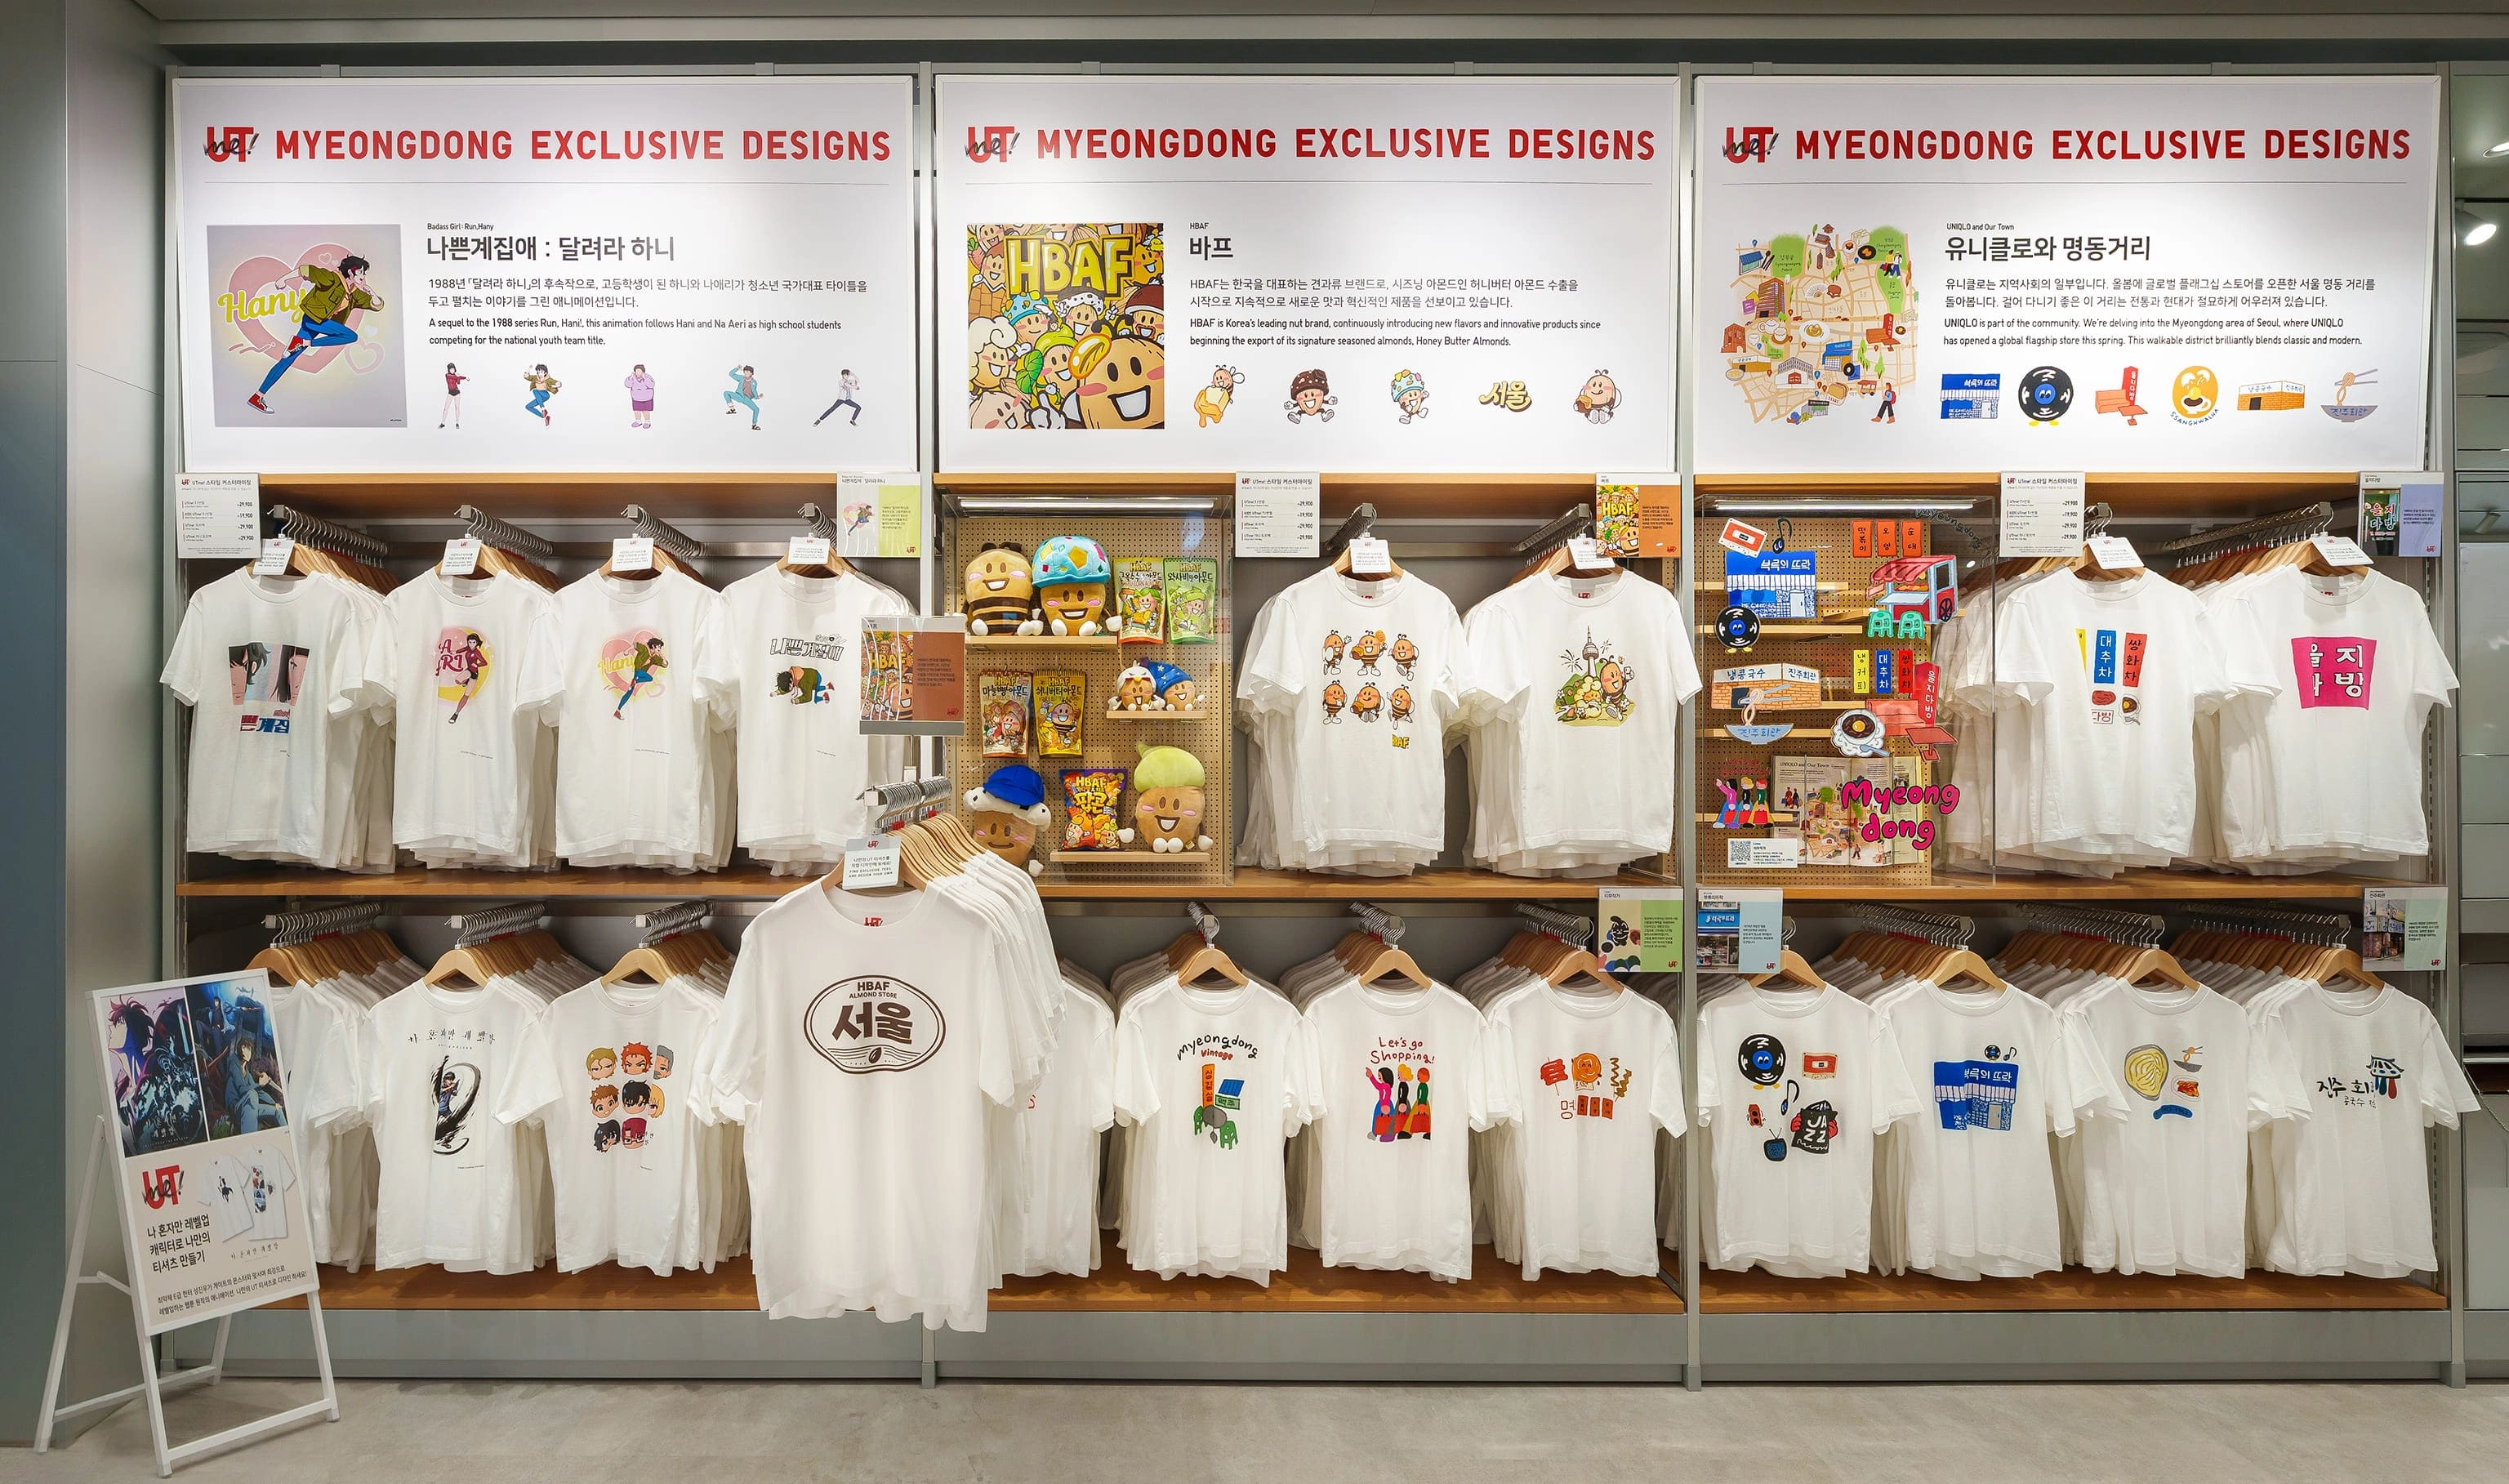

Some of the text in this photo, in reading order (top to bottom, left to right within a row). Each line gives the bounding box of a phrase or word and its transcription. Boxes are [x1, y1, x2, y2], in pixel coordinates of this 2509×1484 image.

[277, 131, 889, 161] MYEONGDONG EXCLUSIVE DESIGNS
[1038, 128, 1654, 160] MYEONGDONG EXCLUSIVE DESIGNS
[1797, 129, 2409, 160] MYEONGDONG EXCLUSIVE DESIGNS
[428, 236, 536, 261] 나쁜계집애
[559, 237, 625, 261] 달려라
[631, 237, 673, 261] 하니
[1190, 236, 1233, 261] 바프
[1945, 236, 2150, 261] 유니클로와 명동거리
[1008, 235, 1134, 296] HBAF
[1191, 279, 1578, 291] HBAF는 한국을 대표하는 견과류 브랜드로, 시즈닝 아몬드인 허니버터 아몬드 수출을
[1945, 296, 2327, 308] 돌아봅니다. 걸어 다니기 좋은 이 거리는 전통과 현대가 절묘하게 어우러져 있습니다.
[430, 319, 435, 327] A
[438, 319, 464, 329] sequel
[466, 319, 474, 327] to
[477, 319, 489, 327] the
[492, 318, 512, 327] 1988
[515, 319, 538, 327] series
[541, 319, 559, 328] Run,
[562, 319, 584, 328] Hani!,
[586, 319, 600, 327] this
[603, 319, 643, 327] animation
[645, 319, 674, 328] follows
[676, 319, 694, 328] Hani
[697, 319, 712, 328] and
[715, 319, 725, 328] Na
[729, 319, 746, 328] Aeri
[760, 320, 776, 331] high
[778, 320, 805, 329] school
[807, 320, 841, 329] students
[430, 336, 605, 346] competing for the national youth team title.
[1478, 381, 1532, 412] 서울
[1602, 501, 1633, 516] HBAF
[870, 653, 907, 669] HBAF
[2098, 635, 2112, 677] 대추차
[1727, 668, 1765, 680] 냉콩국수
[1788, 668, 1816, 680] 진주회관
[1878, 654, 1889, 689] 대추차
[1924, 670, 1936, 719] 을지다방
[1076, 776, 1107, 788] HBAF
[1074, 791, 1107, 814] 팝콘
[1841, 779, 1960, 814] Myeong
[1861, 813, 1936, 850] dong
[858, 982, 889, 992] HBAF
[832, 1001, 913, 1045] 서울
[1379, 1036, 1423, 1050] Let's go
[1370, 1050, 1435, 1064] Shopping!
[147, 1214, 210, 1239] 나 혼자만 레벨업
[149, 1232, 212, 1256] 캐릭터로 나만의
[153, 1250, 206, 1273] 티셔츠 만들기
